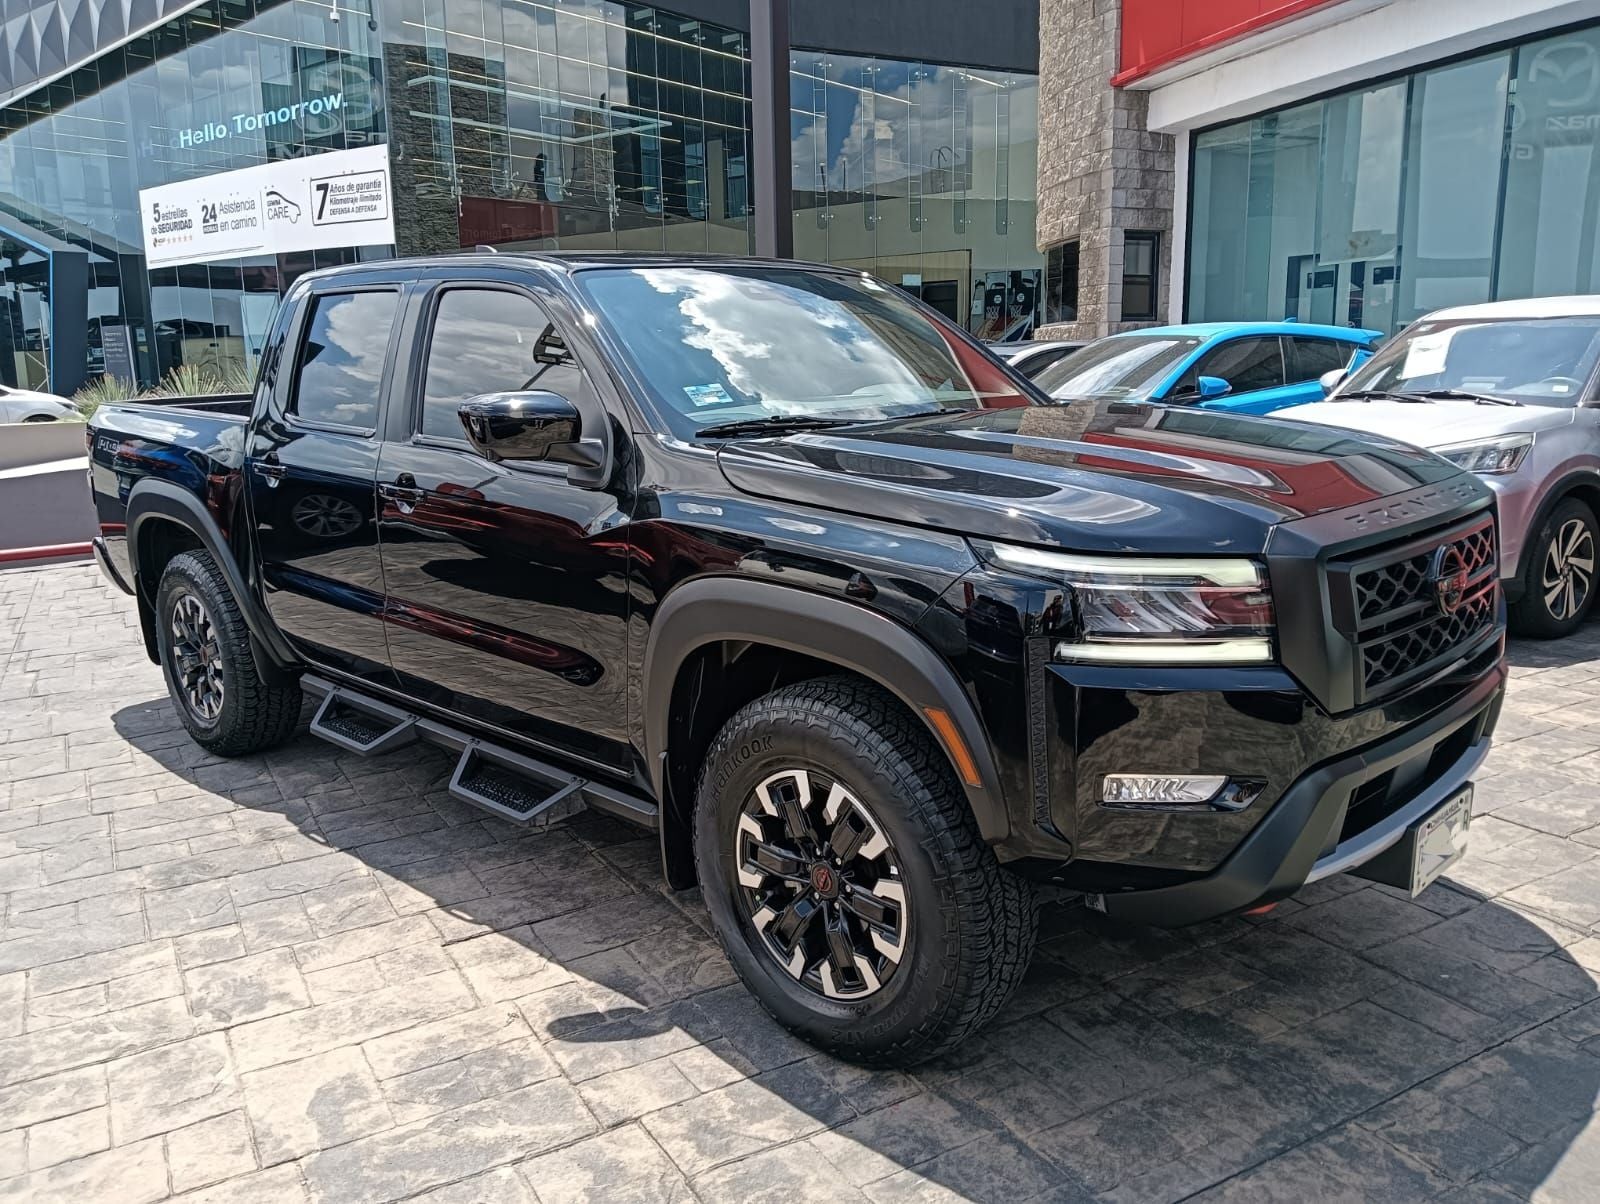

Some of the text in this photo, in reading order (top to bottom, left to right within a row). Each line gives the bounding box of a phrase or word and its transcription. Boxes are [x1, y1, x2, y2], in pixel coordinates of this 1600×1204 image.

[179, 123, 233, 148] Hello,
[233, 93, 349, 134] Tomorrow.
[330, 179, 381, 193] Años de garantía
[219, 199, 255, 215] Asistencia
[316, 183, 329, 220] 7
[153, 203, 188, 223] 5 estrellas
[202, 203, 218, 223] 24
[267, 206, 289, 220] CARE
[151, 219, 193, 235] de SEGURIDAD
[220, 216, 257, 231] en camino
